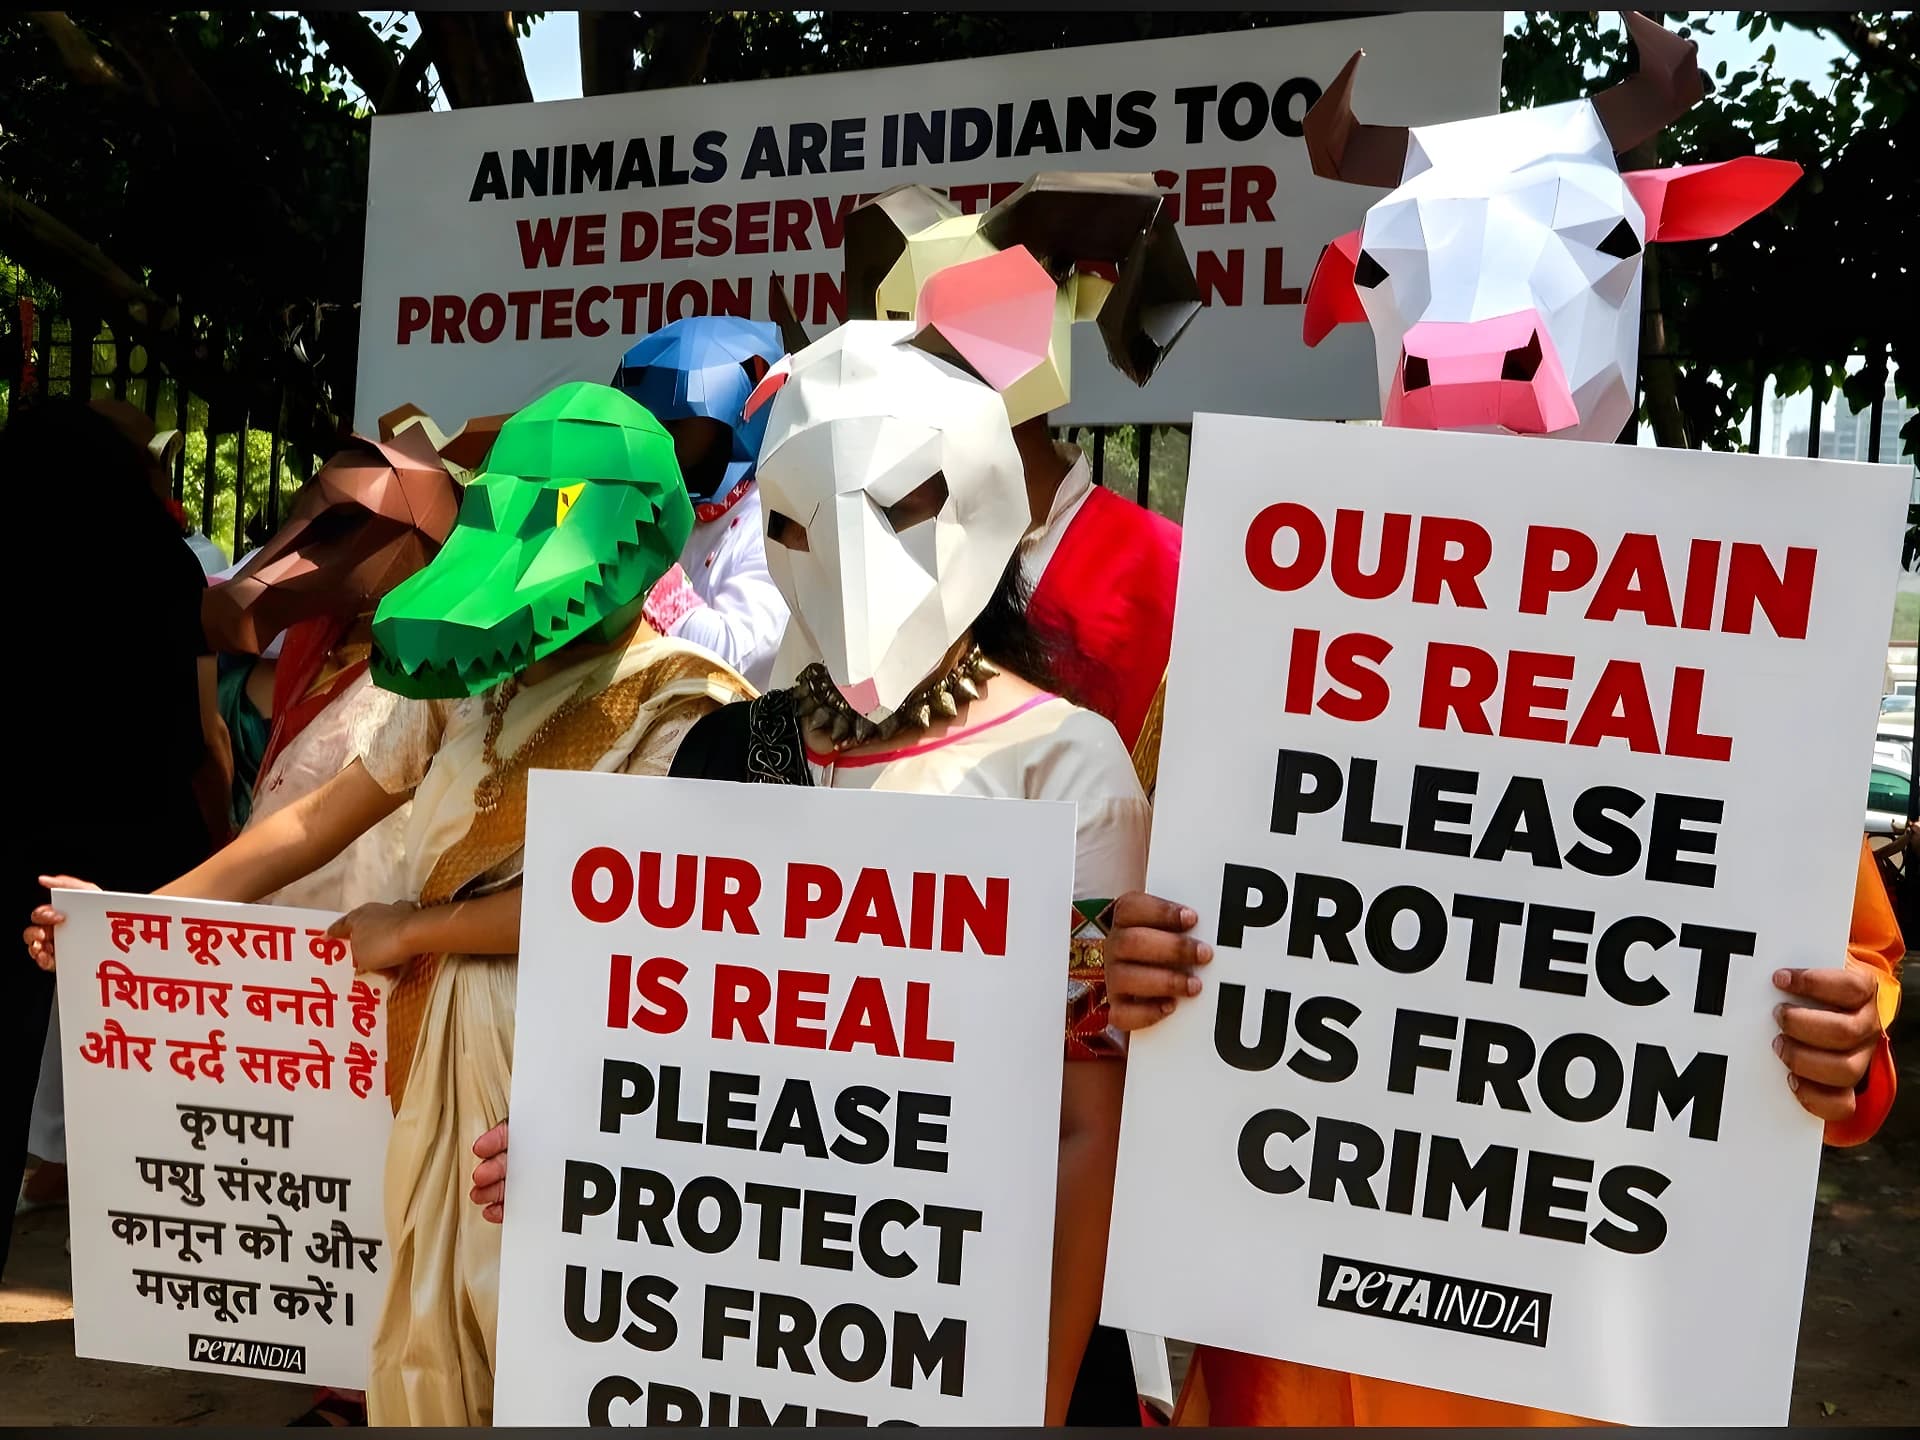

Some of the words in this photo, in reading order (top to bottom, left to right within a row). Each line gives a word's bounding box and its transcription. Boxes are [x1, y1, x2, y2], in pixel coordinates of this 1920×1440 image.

[468, 131, 728, 202] ANIMALS
[741, 118, 867, 180] ARE
[882, 91, 1157, 168] INDIANS
[1175, 77, 1322, 144] TOO
[516, 213, 606, 269] WE
[619, 193, 882, 263] DESERV
[397, 277, 753, 345] PROTECTION
[1245, 502, 1492, 609] OUR
[1518, 525, 1818, 640] PAIN
[1284, 627, 1394, 722] IS
[1418, 642, 1733, 761] REAL
[1270, 749, 1724, 888] PLEASE
[105, 911, 172, 954] हम
[181, 917, 296, 967] क्रूरता
[571, 846, 762, 935] OUR
[783, 863, 1010, 957] PAIN
[1217, 863, 1756, 1016] PROTECT
[96, 959, 233, 1019] शिकार
[242, 977, 339, 1029] बनते
[606, 955, 689, 1035] IS
[712, 964, 955, 1063] REAL
[79, 1018, 157, 1073] और
[165, 1029, 227, 1084] दर्द
[236, 1038, 336, 1092] सहते
[1214, 982, 1362, 1083] US
[1387, 1008, 1729, 1141] FROM
[175, 1103, 294, 1151] कृपया
[599, 1058, 952, 1173] PLEASE
[135, 1156, 205, 1208] पशु
[214, 1157, 352, 1213] संरक्षण
[561, 1160, 983, 1285] PROTECT
[1238, 1109, 1672, 1254] CRIMES
[107, 1209, 227, 1264] कानून
[235, 1214, 293, 1263] को
[304, 1219, 383, 1274] और
[132, 1268, 262, 1324] मज़बूत
[563, 1265, 679, 1352] US
[702, 1284, 967, 1398] FROM
